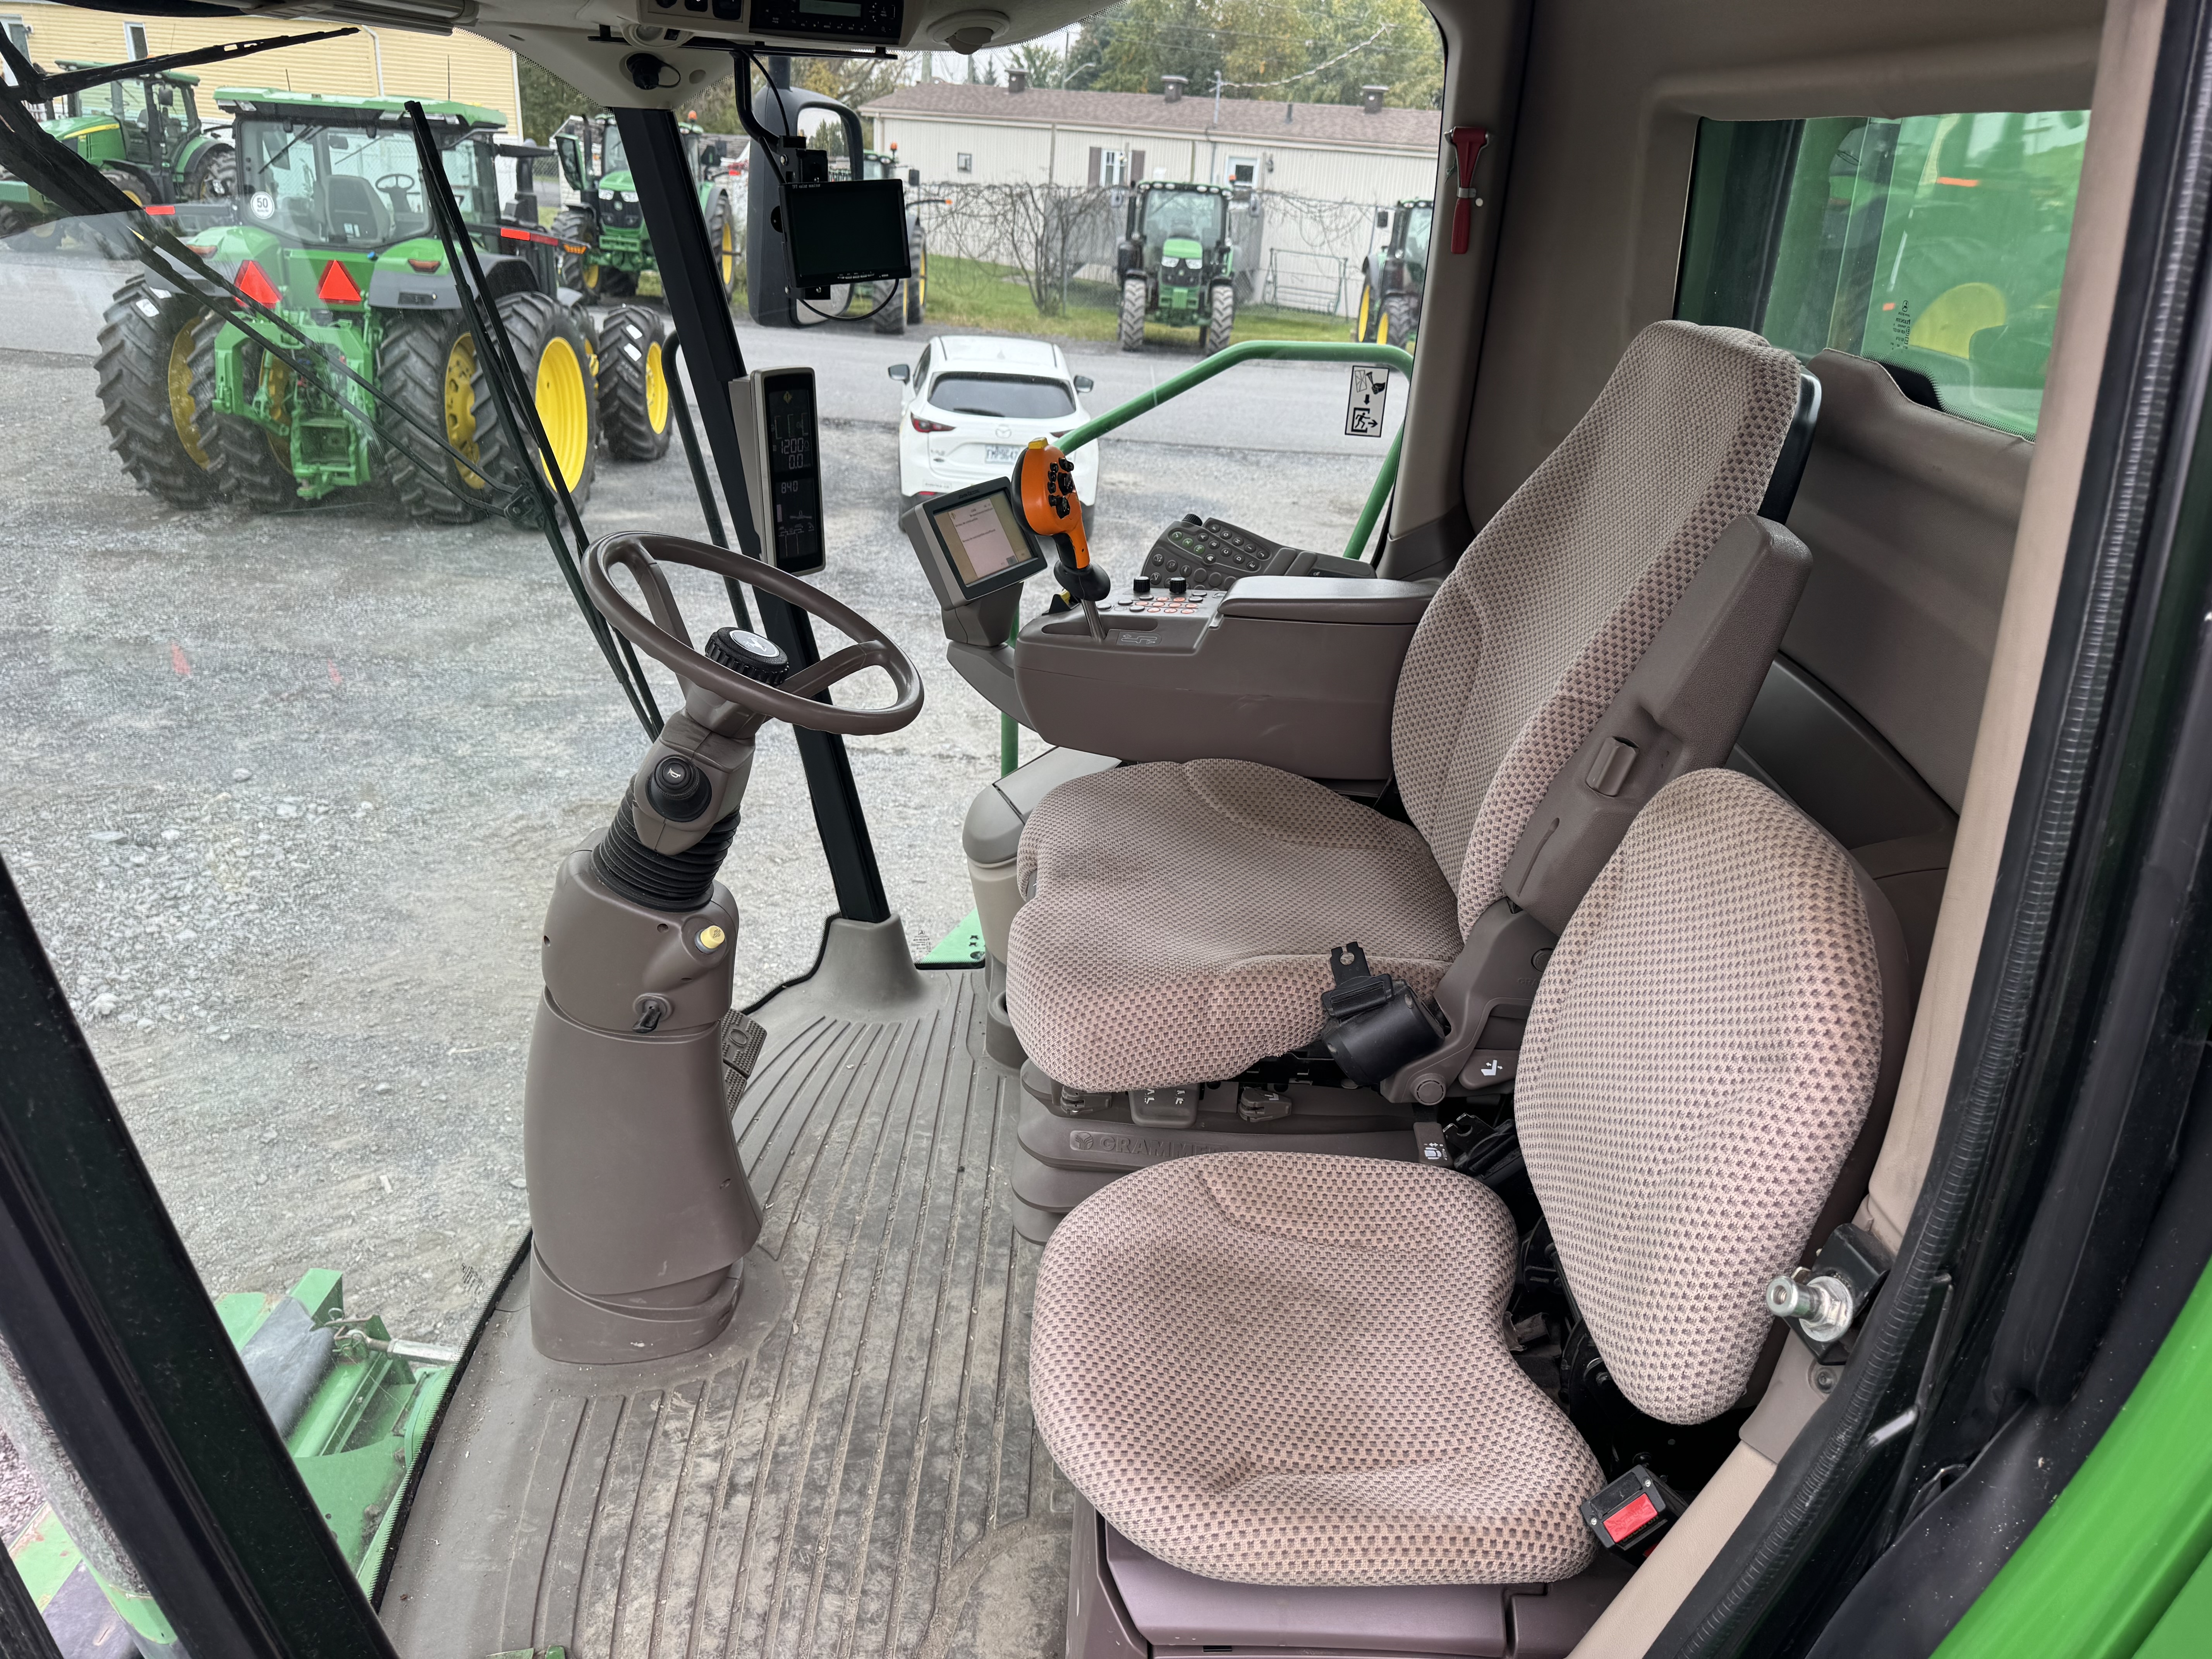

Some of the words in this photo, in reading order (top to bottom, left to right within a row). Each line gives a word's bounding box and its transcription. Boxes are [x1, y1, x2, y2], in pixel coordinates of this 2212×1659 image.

[257, 197, 268, 208] 50
[781, 438, 804, 454] 1200
[789, 453, 803, 469] 0.0
[781, 481, 798, 493] 840
